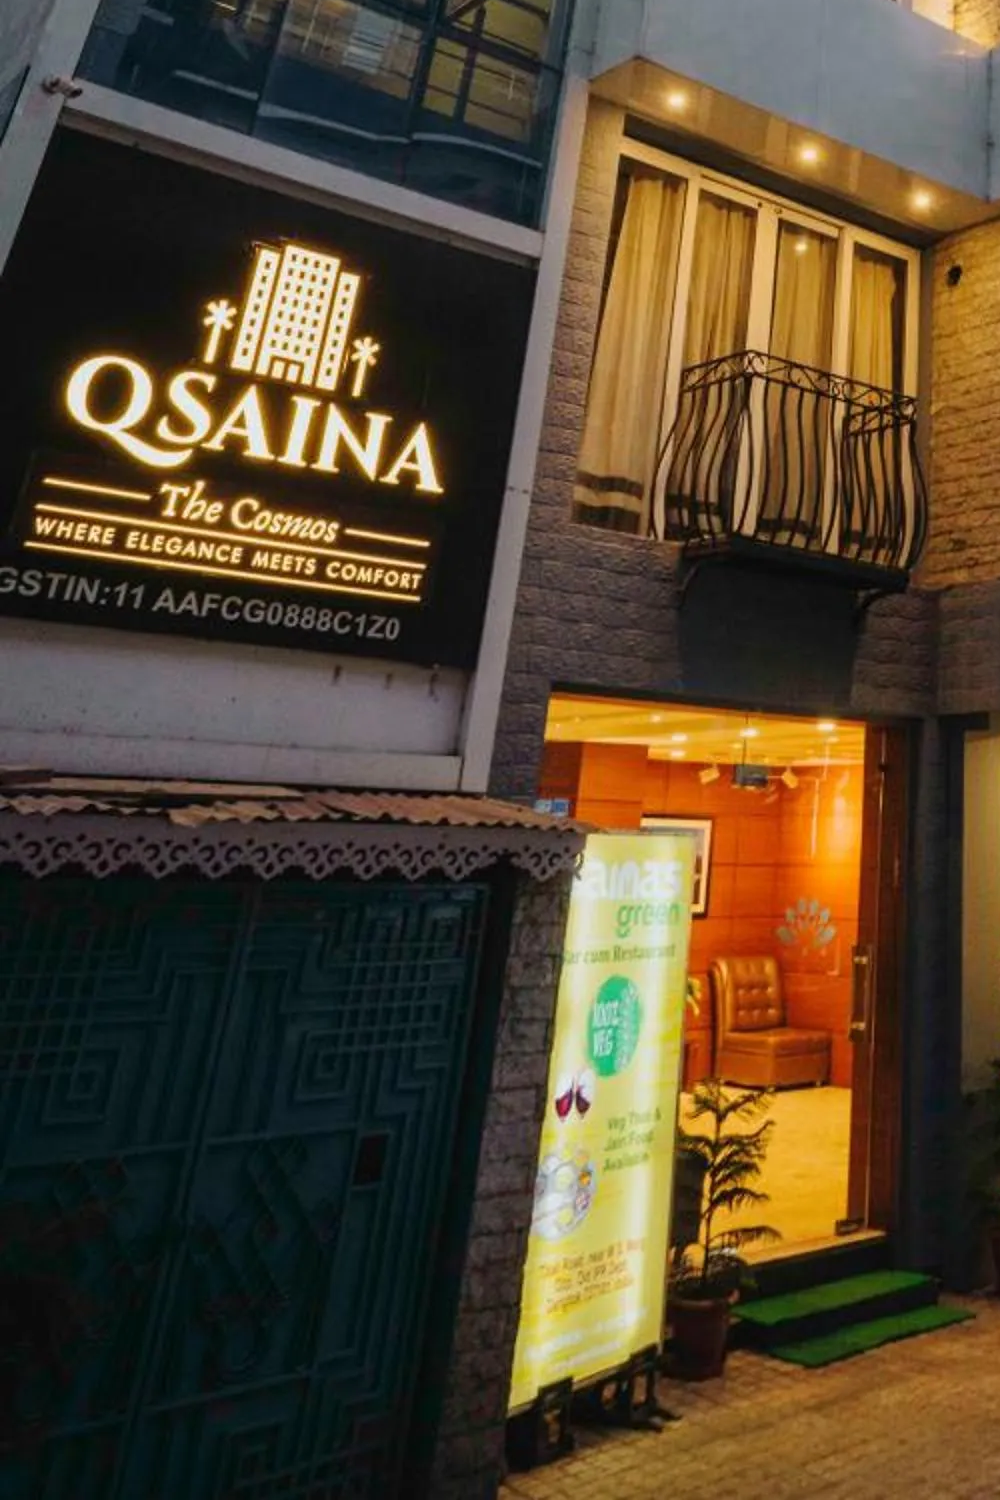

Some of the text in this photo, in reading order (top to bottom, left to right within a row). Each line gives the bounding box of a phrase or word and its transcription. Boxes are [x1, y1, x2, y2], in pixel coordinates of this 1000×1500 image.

[65, 354, 445, 495] QSAINA
[160, 480, 340, 543] The Cosmos
[34, 516, 424, 592] WHERE ELEGANCE MEETS COMFORT
[615, 901, 682, 939] green
